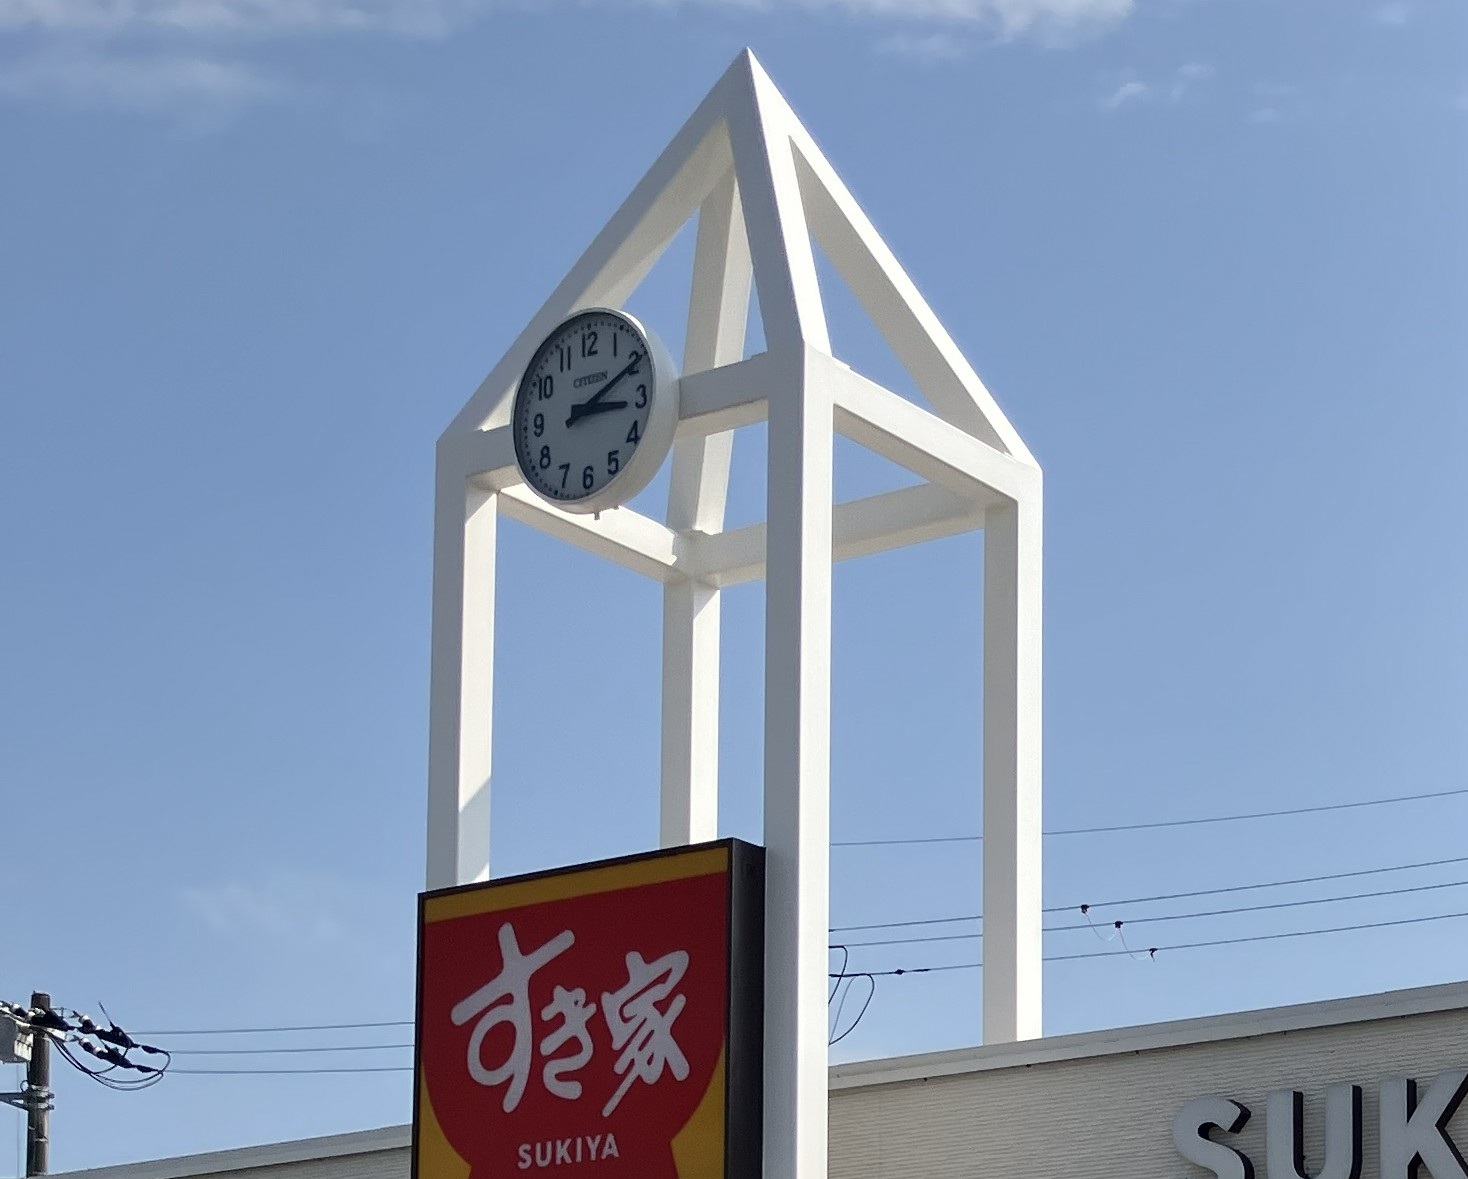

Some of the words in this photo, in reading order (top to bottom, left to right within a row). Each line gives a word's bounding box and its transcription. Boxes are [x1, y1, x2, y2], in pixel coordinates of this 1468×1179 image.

[581, 332, 598, 358] 12
[559, 346, 571, 372] 11
[627, 350, 643, 375] 2
[537, 375, 554, 400] 10
[573, 370, 608, 388] CITIZEN
[635, 384, 647, 409] 3
[533, 413, 544, 437] 9
[626, 420, 640, 445] 4
[539, 446, 551, 469] 8
[607, 450, 619, 476] 5
[559, 463, 570, 489] 7
[582, 465, 594, 489] 6
[451, 922, 690, 1117] すき家
[517, 1132, 619, 1169] SUKIYA
